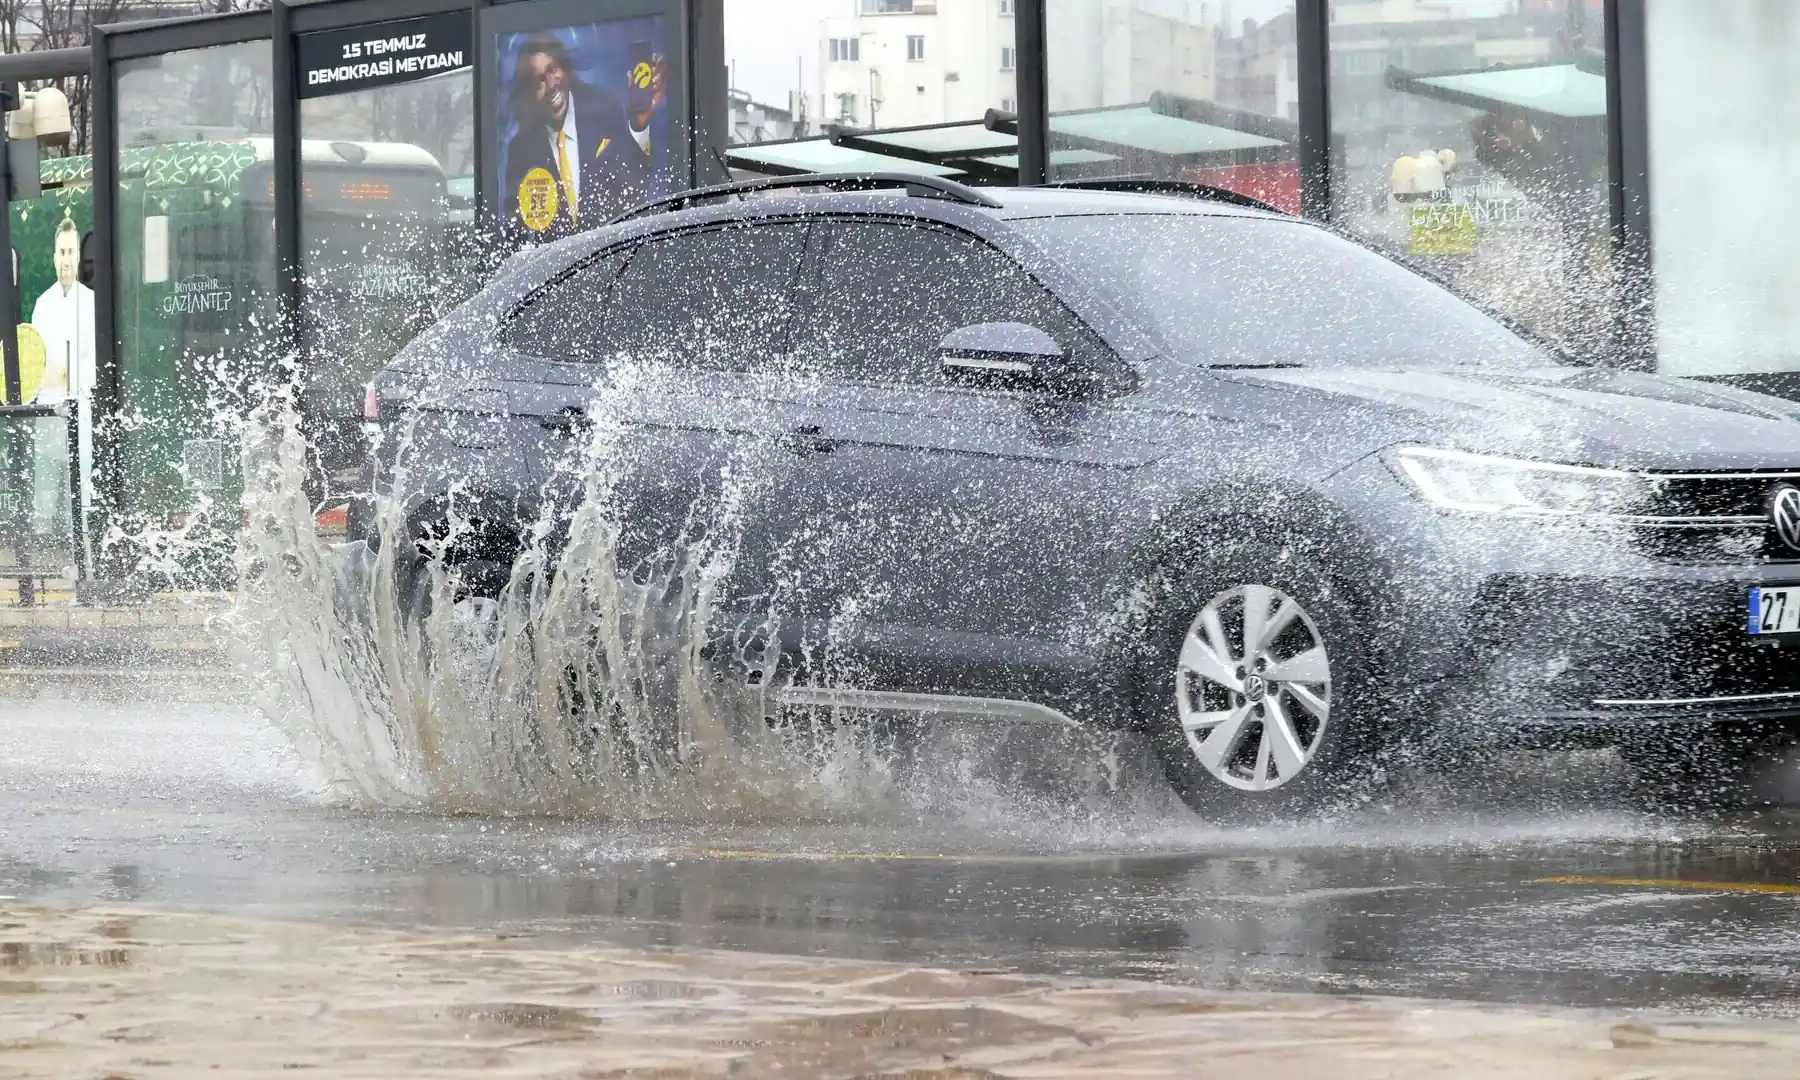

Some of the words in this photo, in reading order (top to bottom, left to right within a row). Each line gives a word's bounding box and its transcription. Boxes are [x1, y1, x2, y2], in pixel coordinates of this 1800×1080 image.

[342, 43, 361, 59] 15
[364, 33, 427, 54] TEMMUZ
[308, 57, 394, 85] DEMOKRASİ
[396, 50, 463, 74] MEYDANI
[163, 290, 232, 316] GAZİANTEP
[1761, 591, 1788, 631] 27
